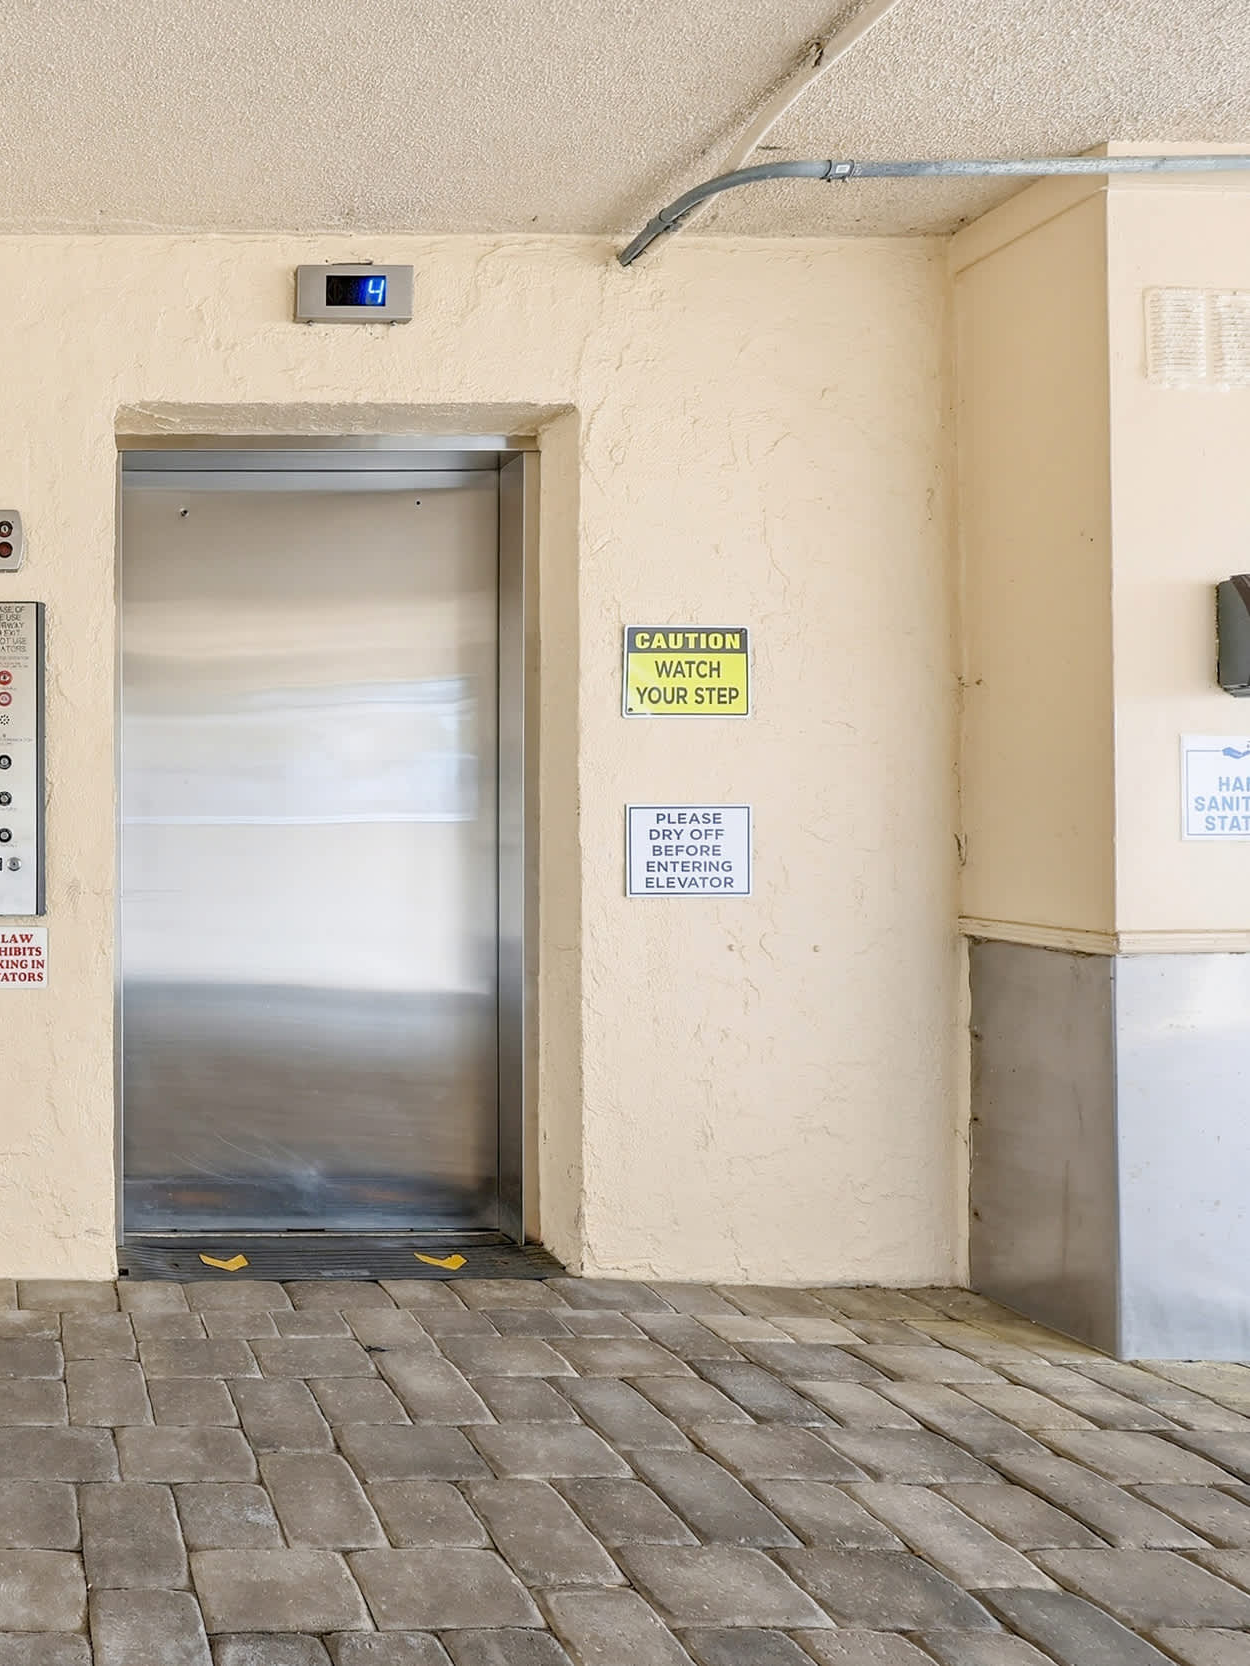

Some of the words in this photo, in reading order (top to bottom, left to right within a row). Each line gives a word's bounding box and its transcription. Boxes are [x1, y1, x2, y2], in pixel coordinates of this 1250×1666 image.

[368, 279, 385, 304] 4
[14, 605, 25, 613] OF
[5, 613, 21, 621] USE
[13, 637, 27, 645] USE
[635, 633, 741, 650] CAUTION
[654, 660, 721, 678] WATCH
[636, 686, 688, 705] YOUR
[694, 687, 740, 705] STEP
[656, 812, 723, 825] PLEASE
[649, 828, 685, 841] DRY
[689, 828, 725, 841] OFF
[652, 844, 722, 857] BEFORE
[646, 860, 733, 873] ENTERING
[645, 876, 735, 889] ELEVATOR
[1, 933, 34, 944] LAW
[31, 959, 45, 970] IN
